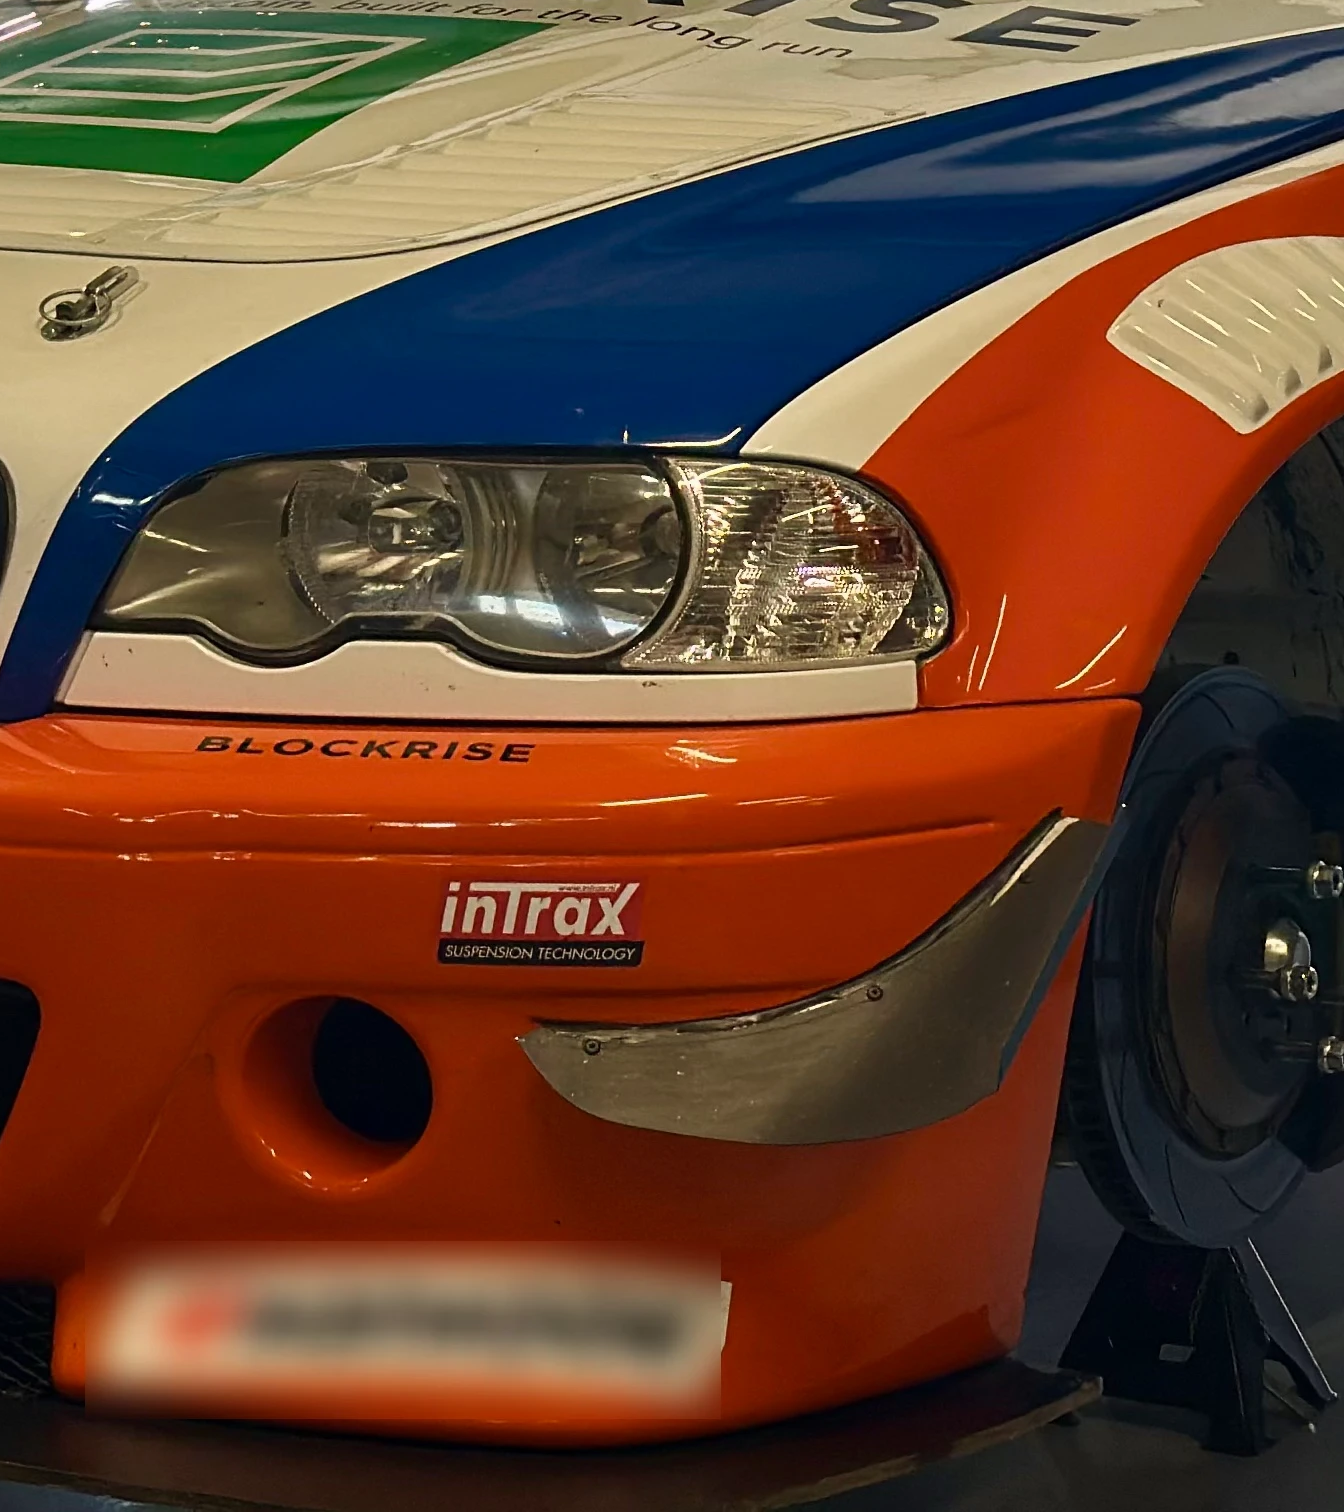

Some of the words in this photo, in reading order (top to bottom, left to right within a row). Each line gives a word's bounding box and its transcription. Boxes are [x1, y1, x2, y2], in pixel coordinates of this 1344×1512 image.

[453, 2, 532, 18] for
[536, 8, 622, 25] the
[628, 15, 752, 50] long
[195, 735, 536, 763] BLOCKRISE
[441, 881, 640, 936] inTrax
[445, 945, 534, 959] SUSPENSION
[538, 947, 637, 961] TECHNOLOGY
